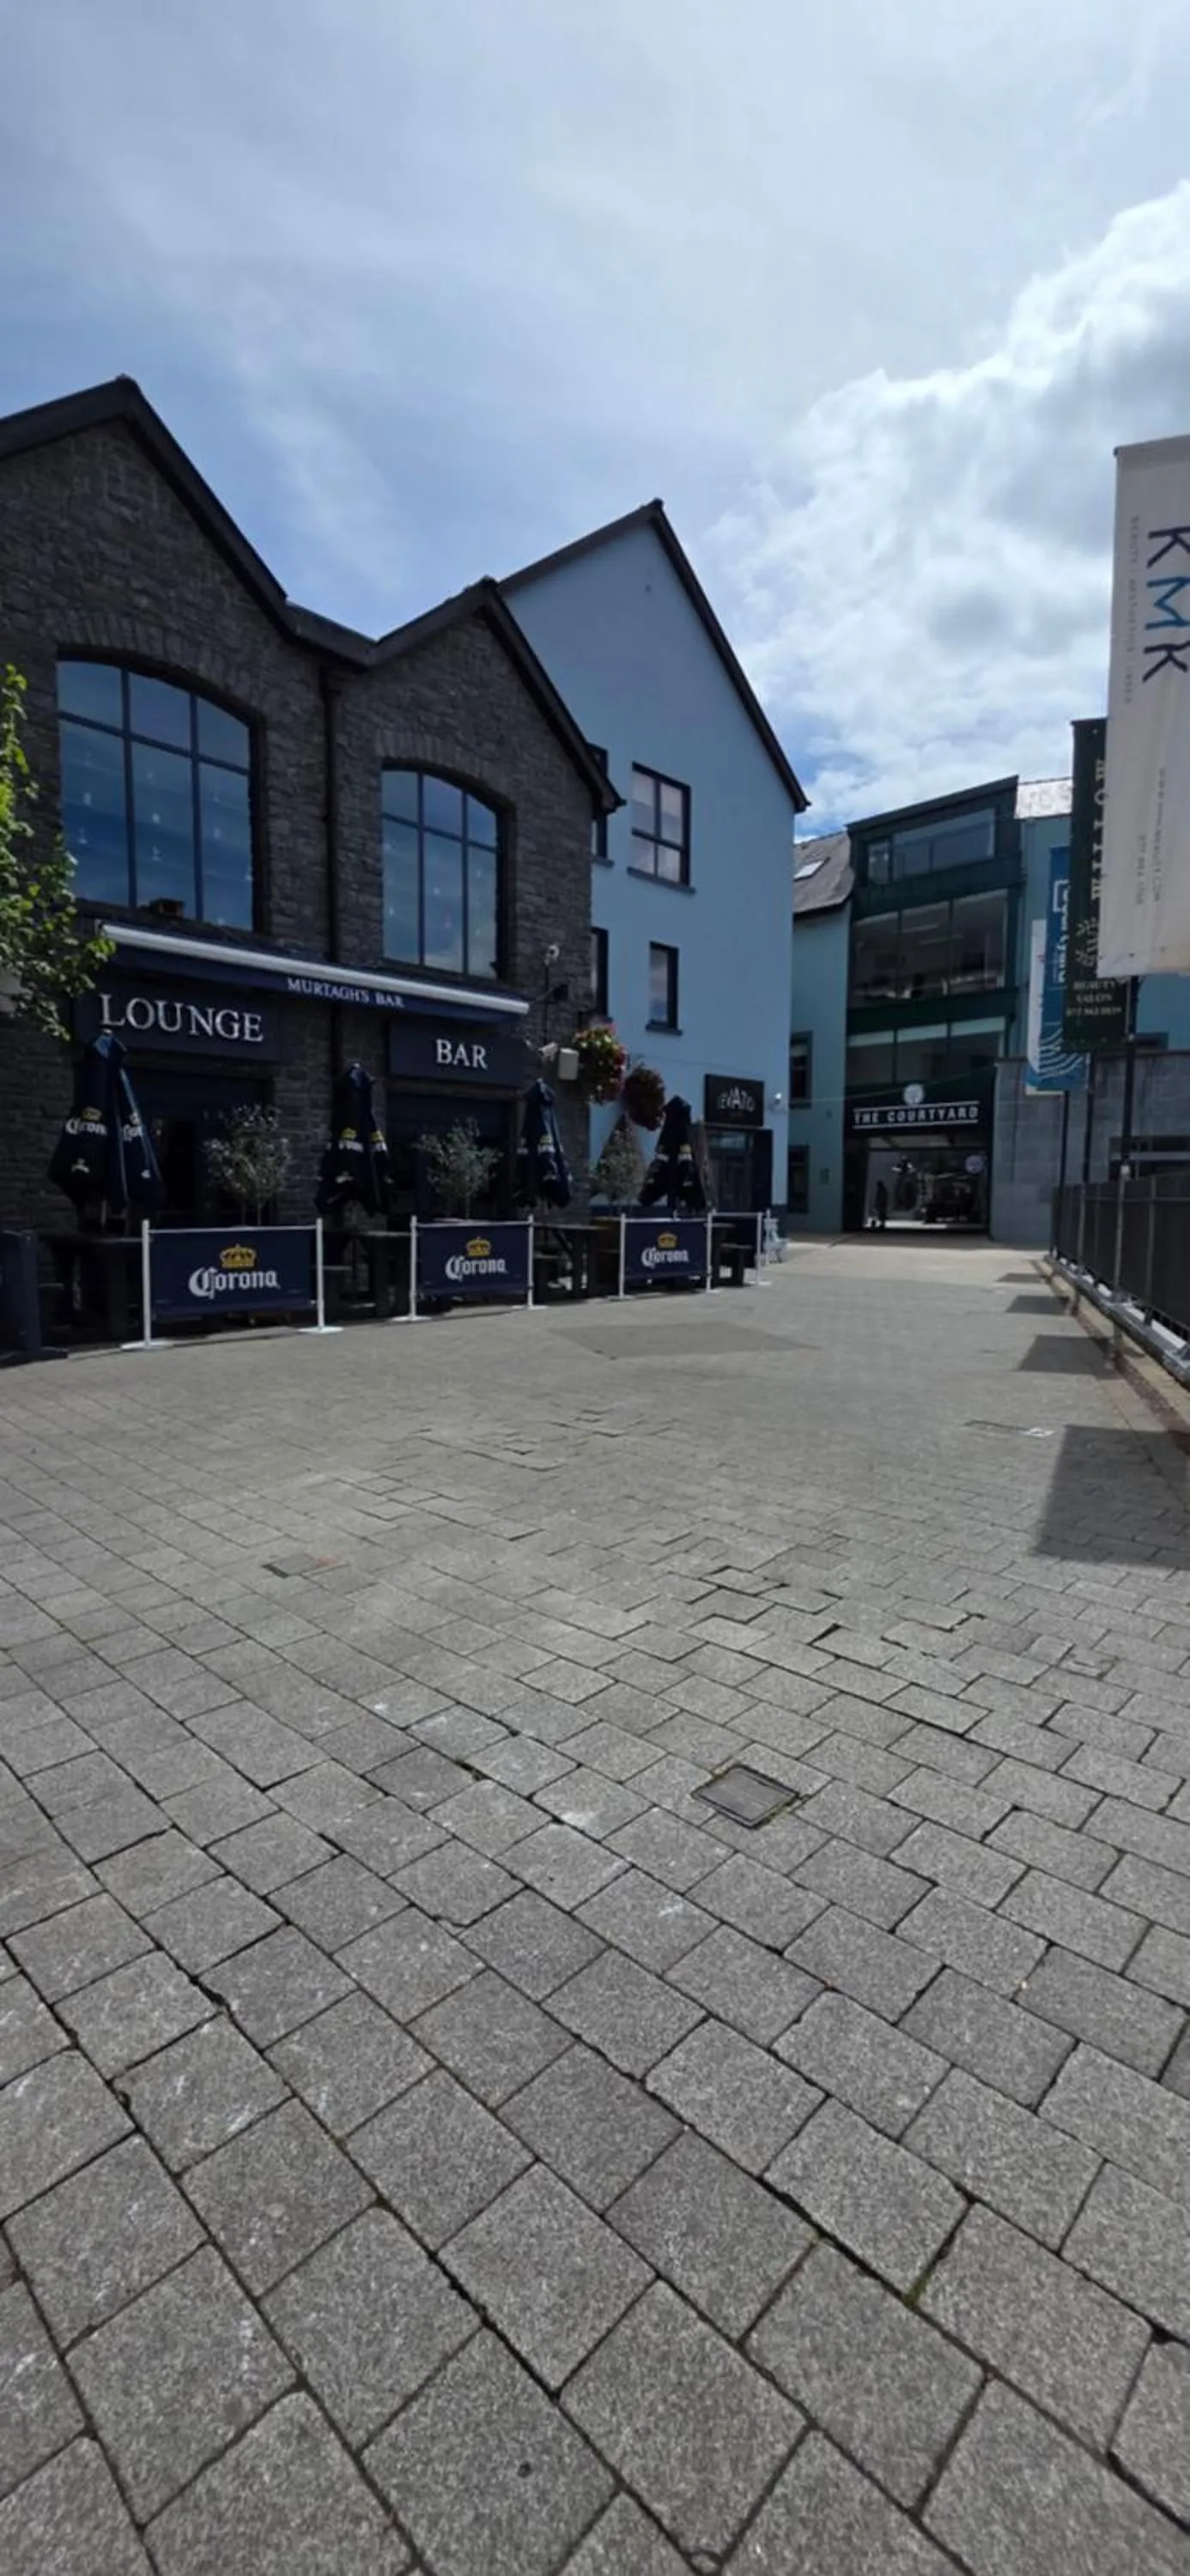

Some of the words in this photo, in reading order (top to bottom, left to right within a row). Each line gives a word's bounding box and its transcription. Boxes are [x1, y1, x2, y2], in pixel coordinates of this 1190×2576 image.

[1142, 525, 1190, 683] KMK
[287, 977, 370, 1005] MURTAGH'S
[375, 990, 406, 1009] BAR
[1076, 993, 1114, 1004] SALON
[99, 993, 264, 1042] LOUNGE
[435, 1038, 489, 1070] BAR
[853, 1111, 879, 1124] THE
[886, 1105, 980, 1123] COURTYARD
[445, 1255, 508, 1282] Corona
[641, 1245, 690, 1269] Corona
[188, 1267, 280, 1299] Corona
